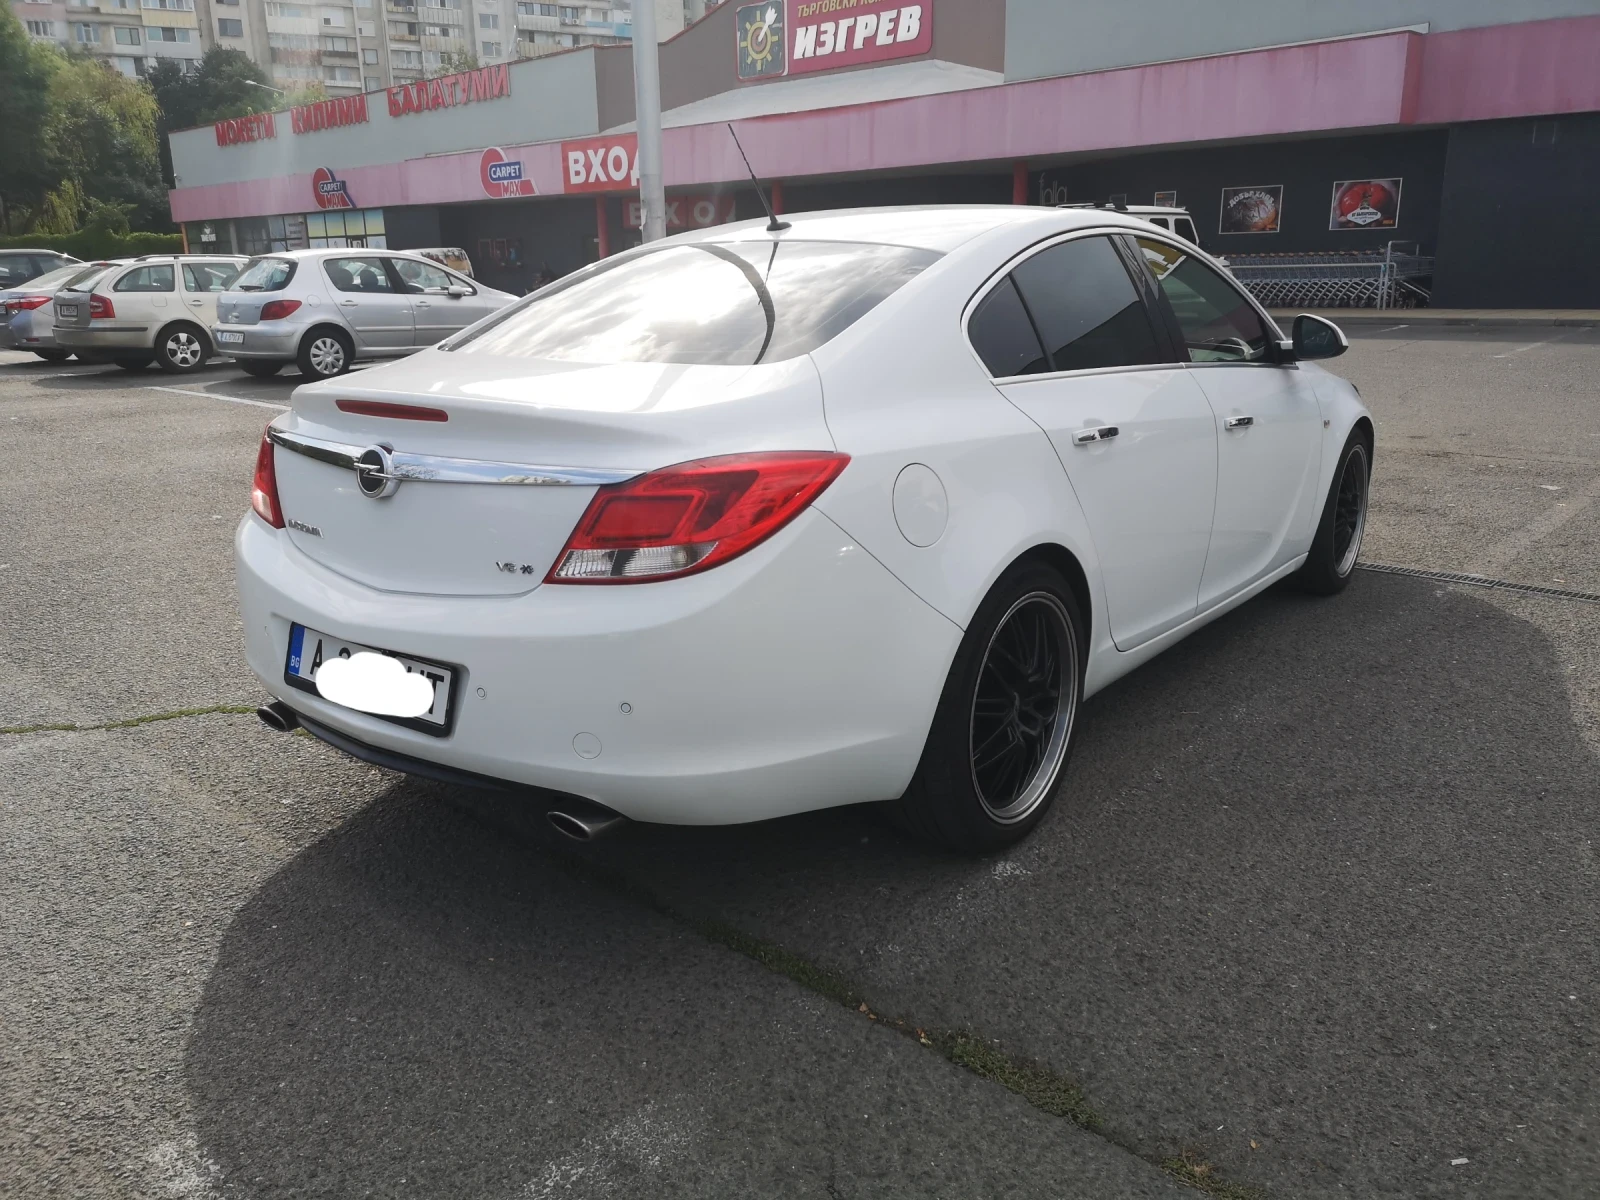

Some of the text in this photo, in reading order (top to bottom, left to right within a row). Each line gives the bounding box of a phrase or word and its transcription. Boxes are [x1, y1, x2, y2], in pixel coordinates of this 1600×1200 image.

[793, 5, 922, 60] ИЗГРЕВ
[290, 94, 369, 134] КИЛИМИ
[386, 63, 511, 118] БАЛАТУМИ
[490, 165, 520, 179] CARPET
[320, 182, 341, 192] CARPET
[501, 180, 522, 198] MAX
[325, 192, 343, 209] MAX
[290, 655, 300, 668] BG
